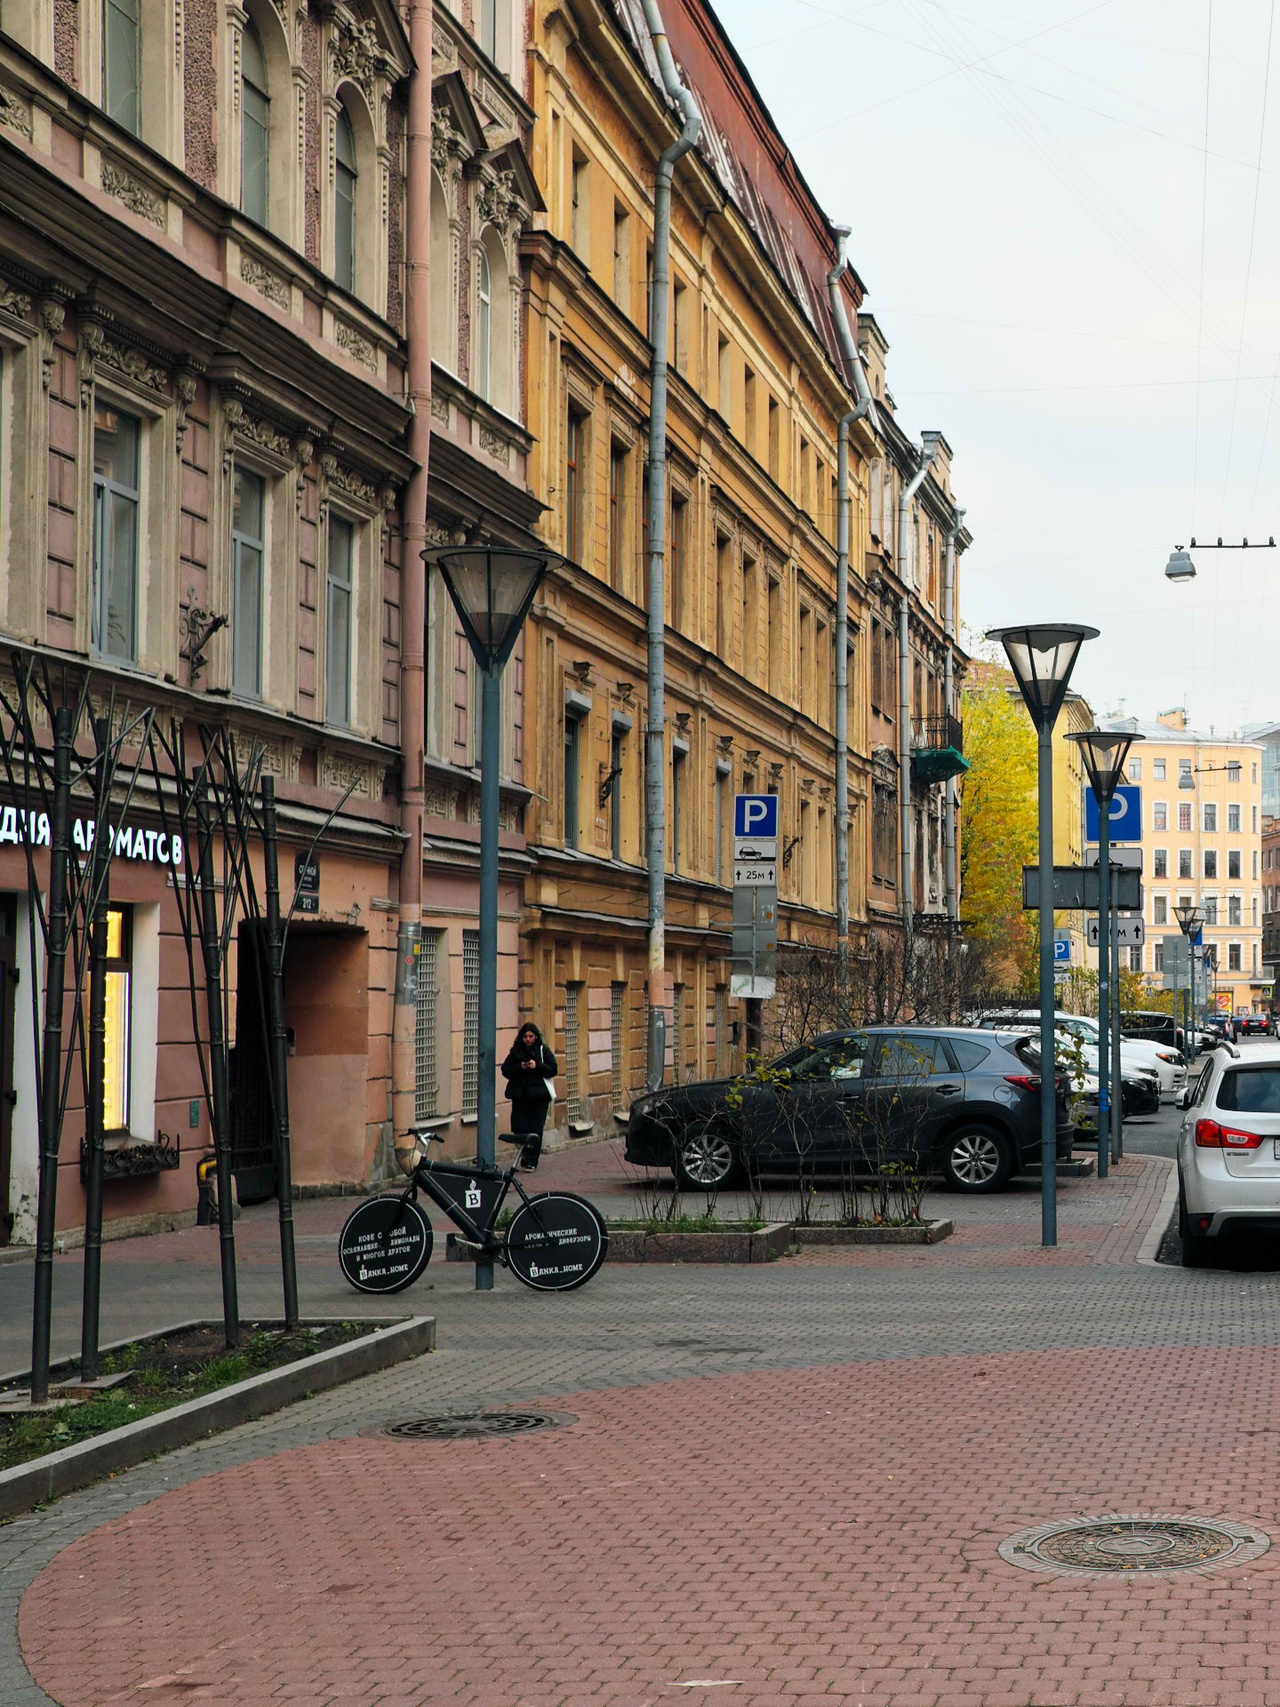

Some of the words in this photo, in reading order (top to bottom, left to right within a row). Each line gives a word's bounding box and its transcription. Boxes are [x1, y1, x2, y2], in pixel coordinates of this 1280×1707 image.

[744, 800, 768, 833] P
[0, 805, 50, 846] ДИЯ
[1054, 942, 1065, 958] P
[358, 1233, 375, 1243] КОФЕ
[390, 1226, 406, 1237] ОБОЙ
[524, 1228, 578, 1241] АРОМАИЧЕСКИЕ
[363, 1250, 385, 1261] МНОГОЕ
[387, 1245, 411, 1257] ДРУГОЕ
